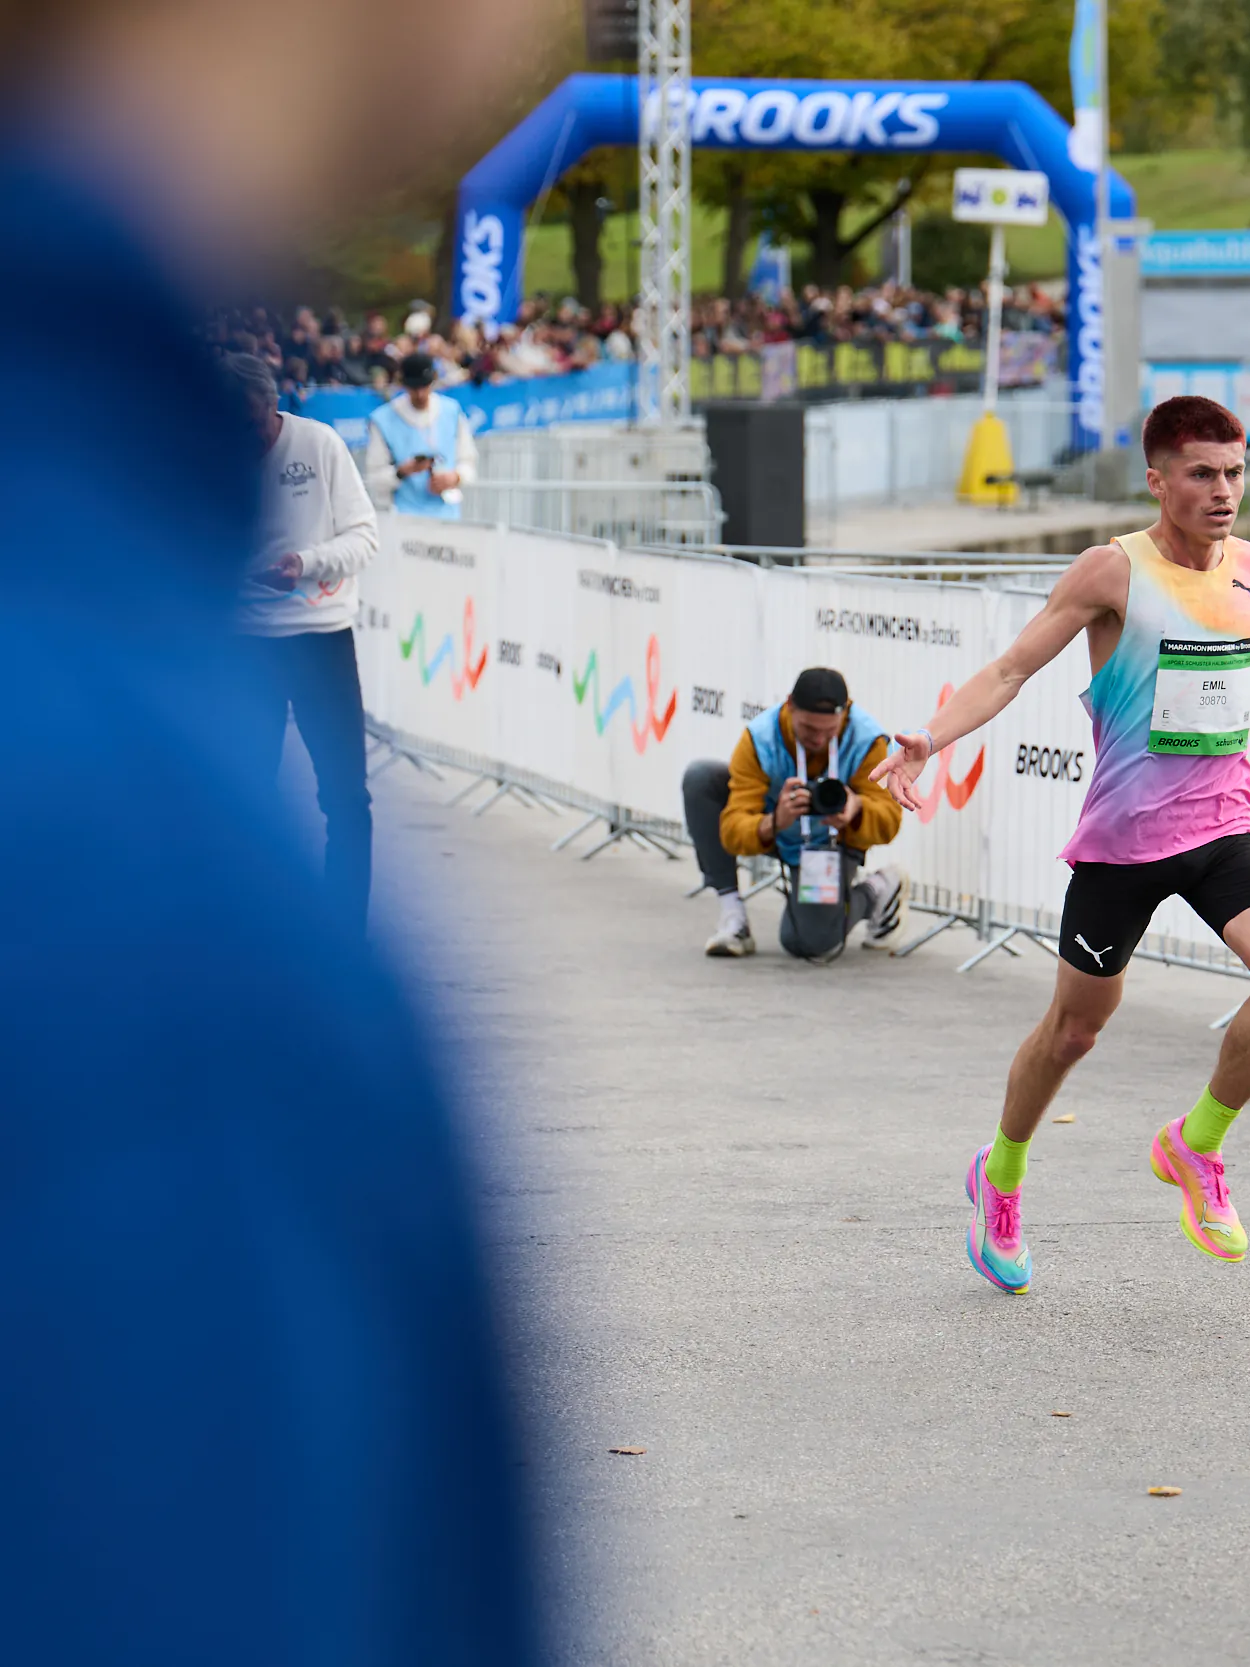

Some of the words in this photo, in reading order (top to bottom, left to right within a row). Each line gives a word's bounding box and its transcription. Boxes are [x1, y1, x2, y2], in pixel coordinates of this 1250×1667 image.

[461, 207, 504, 322] OKS
[1202, 681, 1226, 690] EMIL
[1200, 696, 1227, 705] 30870
[1163, 710, 1170, 718] E
[1158, 738, 1200, 747] BROOKS
[1016, 744, 1083, 782] BROOKS
